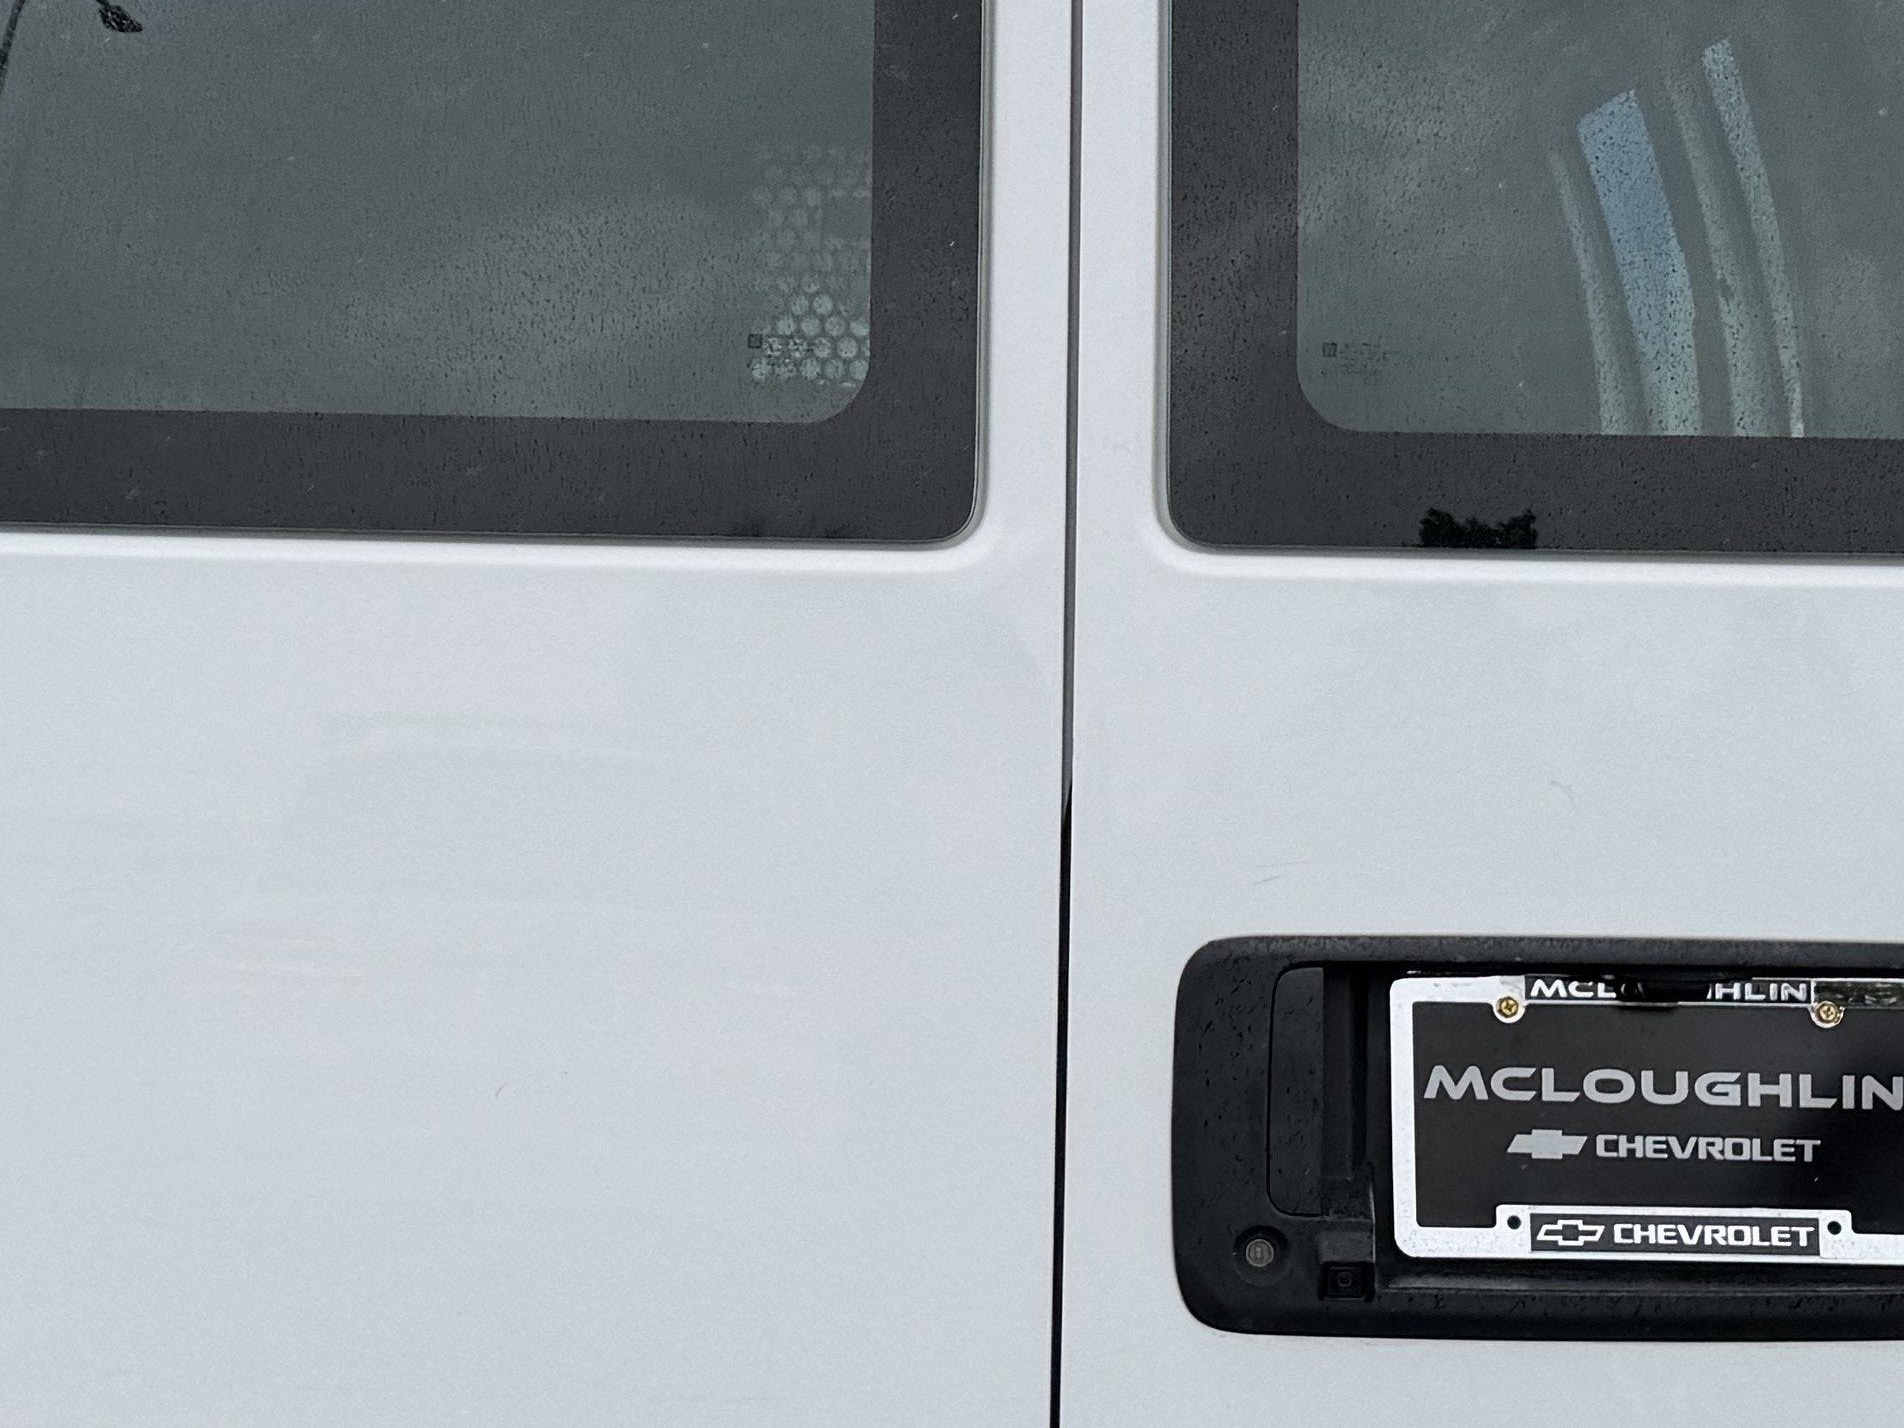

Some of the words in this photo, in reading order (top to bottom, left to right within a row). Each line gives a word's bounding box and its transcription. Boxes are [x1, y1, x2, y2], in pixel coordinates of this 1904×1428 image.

[1423, 1064, 1904, 1111] MCLOUGHLIN
[1595, 1134, 1822, 1162] CHEVROLET
[1614, 1222, 1816, 1248] CHEVROLET
